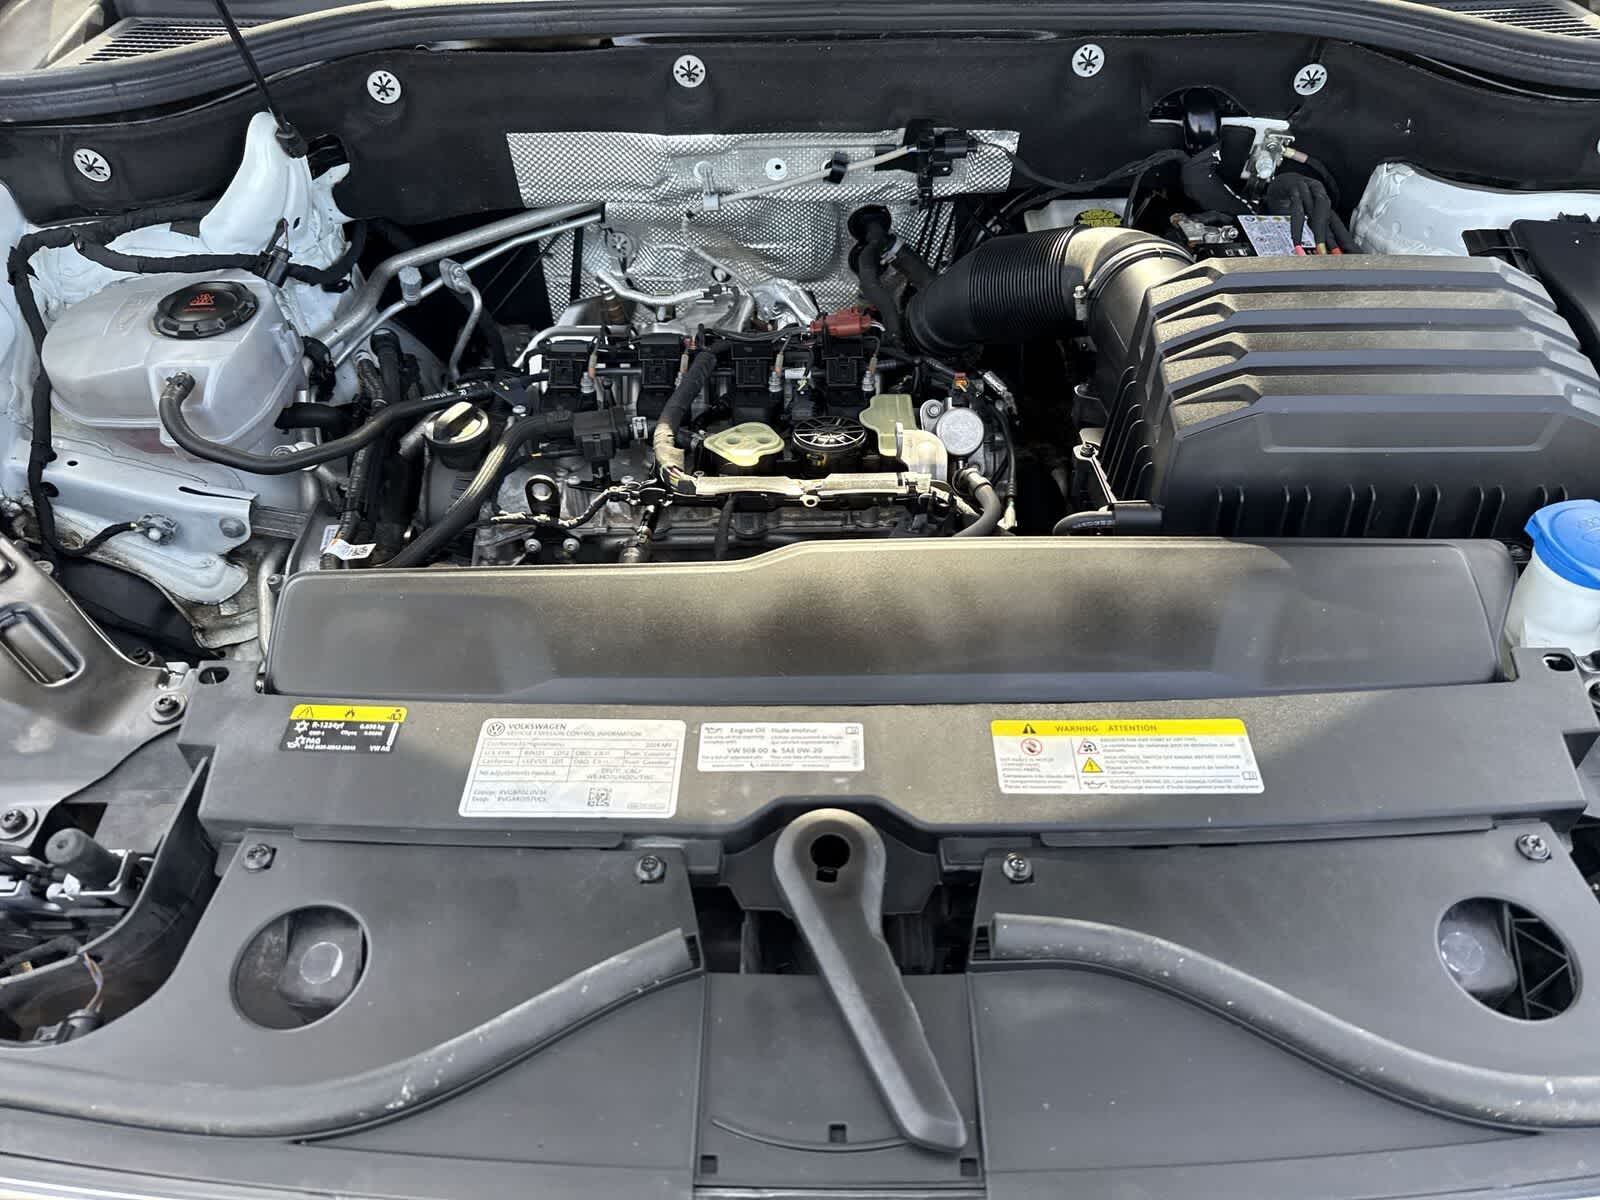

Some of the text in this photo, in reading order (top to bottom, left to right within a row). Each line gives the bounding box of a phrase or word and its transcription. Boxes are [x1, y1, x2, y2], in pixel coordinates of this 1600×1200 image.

[508, 723, 568, 731] VOLKSWAGEN
[730, 727, 754, 735] Engine
[1055, 724, 1158, 733] WARNING ATTENTION
